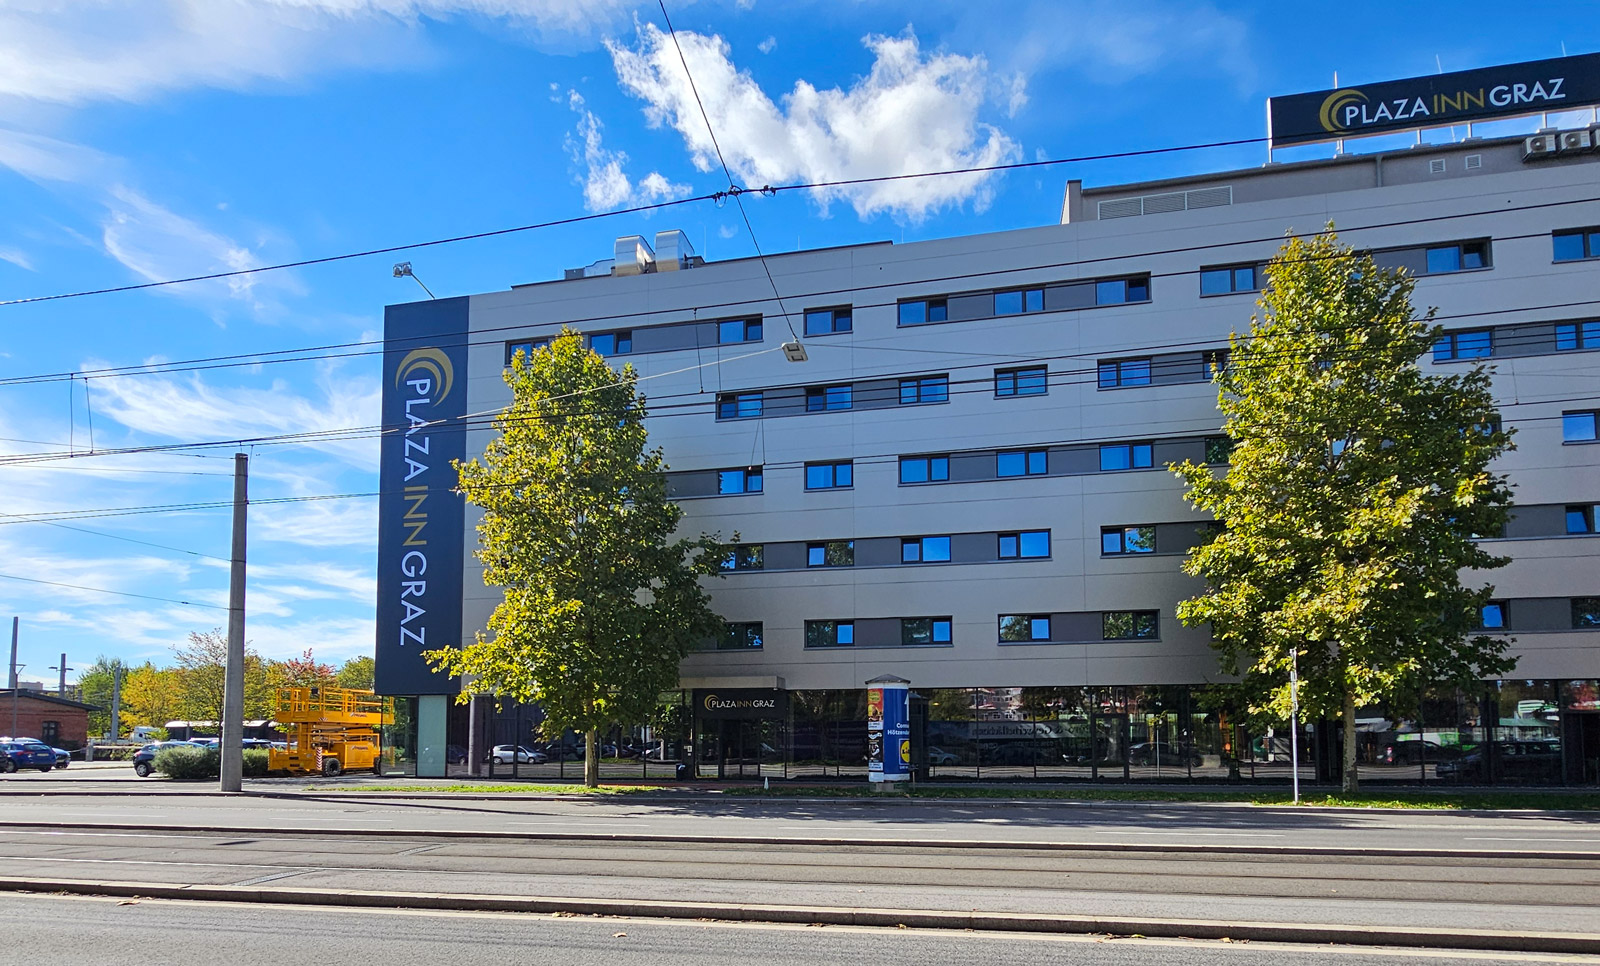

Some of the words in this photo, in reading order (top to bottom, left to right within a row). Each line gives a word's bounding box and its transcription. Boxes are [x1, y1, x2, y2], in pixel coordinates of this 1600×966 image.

[1345, 97, 1430, 126] PLAZA
[1434, 88, 1485, 114] INN
[1489, 78, 1566, 107] GRAZ
[404, 377, 431, 482] PLAZA
[402, 485, 429, 546] INN
[400, 550, 427, 646] GRAZ
[711, 700, 737, 708] PLAZA
[736, 700, 752, 708] INN
[752, 699, 775, 708] GRAZ
